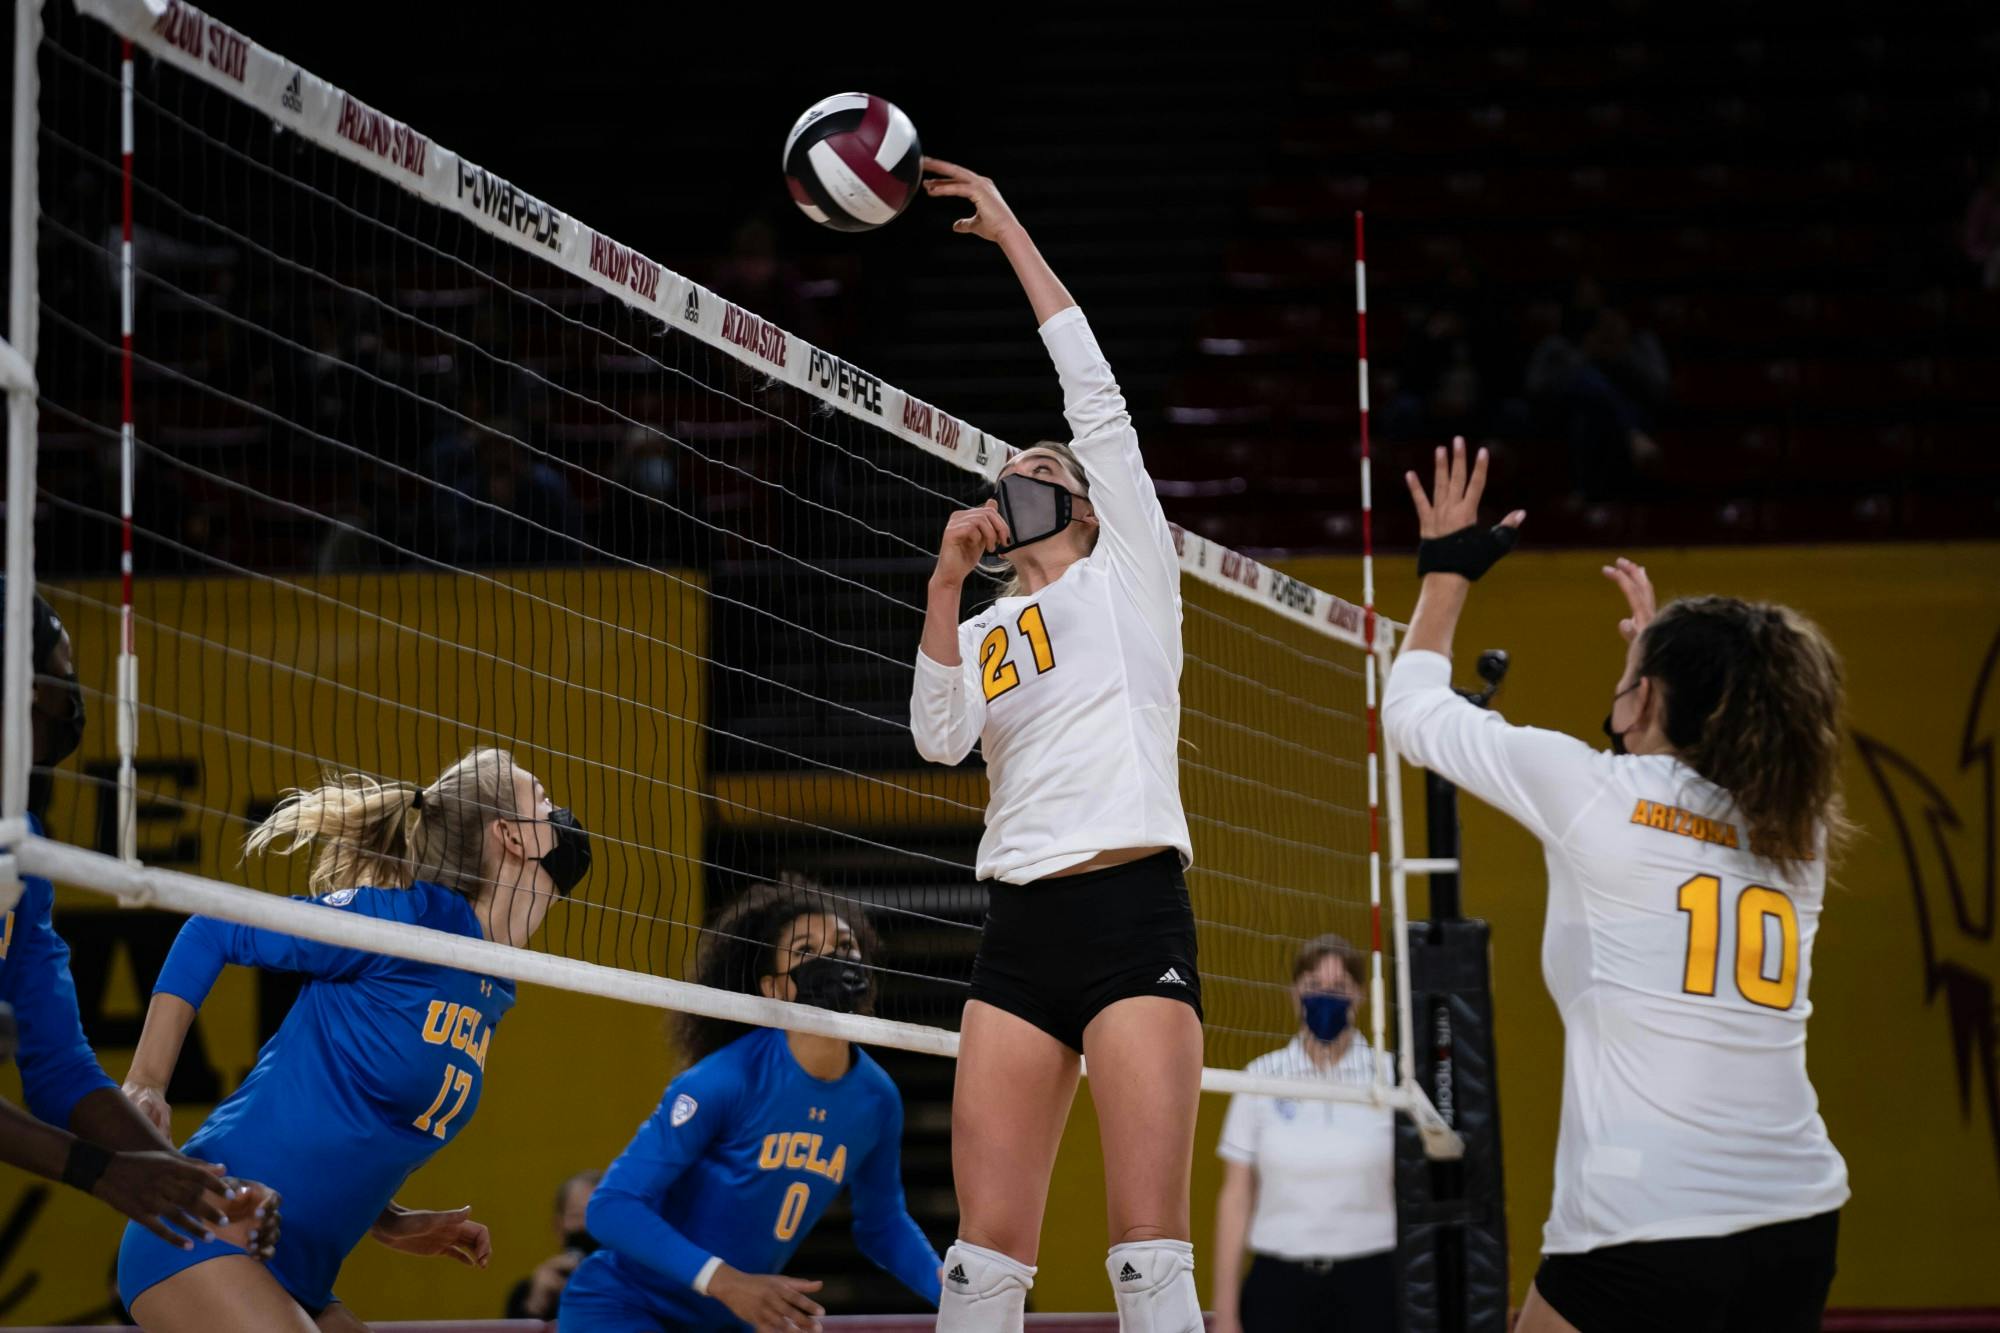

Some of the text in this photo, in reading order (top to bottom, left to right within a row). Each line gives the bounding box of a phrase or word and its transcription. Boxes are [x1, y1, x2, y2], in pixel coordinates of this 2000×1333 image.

[980, 602, 1056, 704] 21
[1677, 873, 1801, 1011] 10
[422, 1000, 491, 1072] UCLA
[412, 1063, 472, 1140] 17
[758, 1132, 847, 1185] UCLA
[774, 1181, 810, 1241] 0
[947, 1273, 969, 1285] adidas
[1119, 1272, 1142, 1282] adidas
